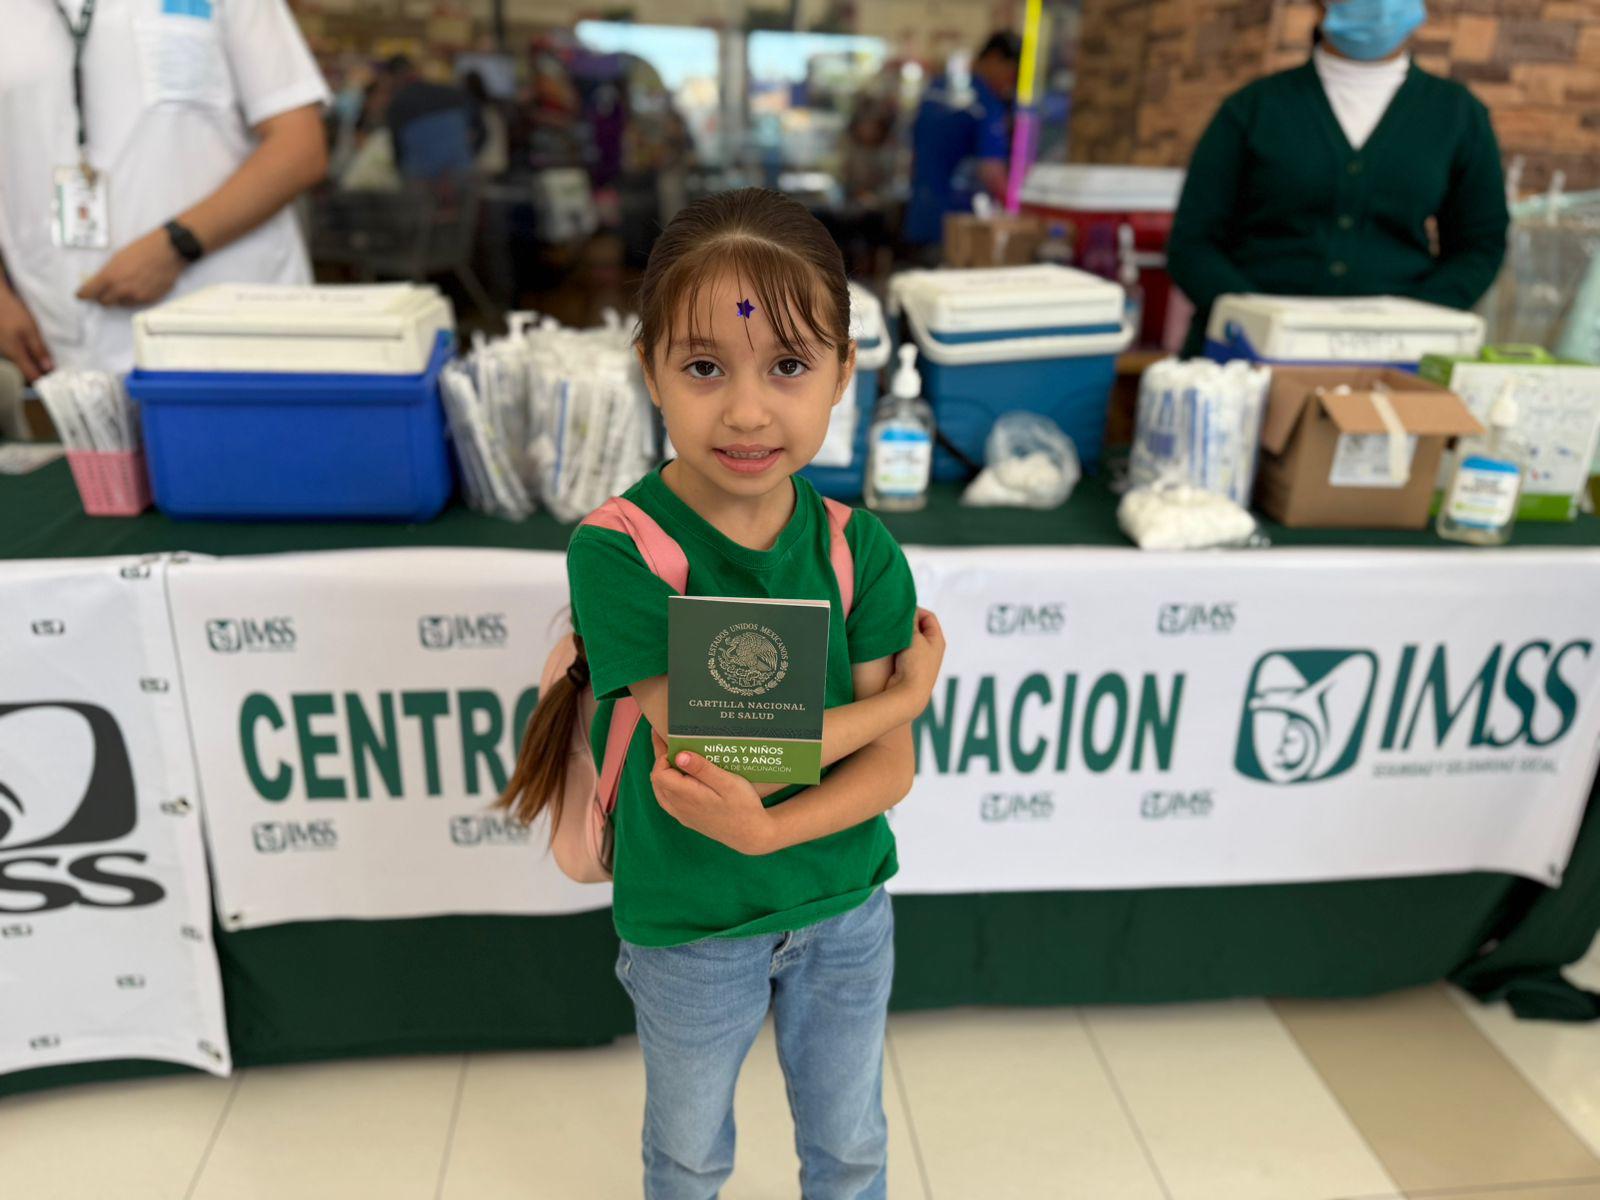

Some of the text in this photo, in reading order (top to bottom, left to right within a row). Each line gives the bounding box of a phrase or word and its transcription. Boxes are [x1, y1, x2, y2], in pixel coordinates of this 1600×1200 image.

[708, 622, 789, 660] ESTADOS UNIDOS MEXICANOS
[1379, 638, 1594, 752] IMSS
[688, 699, 806, 711] CARTILLA NACIONAL
[720, 711, 775, 720] DE SALUD
[704, 744, 784, 755] NIÑAS Y NIÑOS
[705, 755, 721, 763] DE
[742, 756, 749, 764] 9
[751, 755, 782, 765] AÑOS
